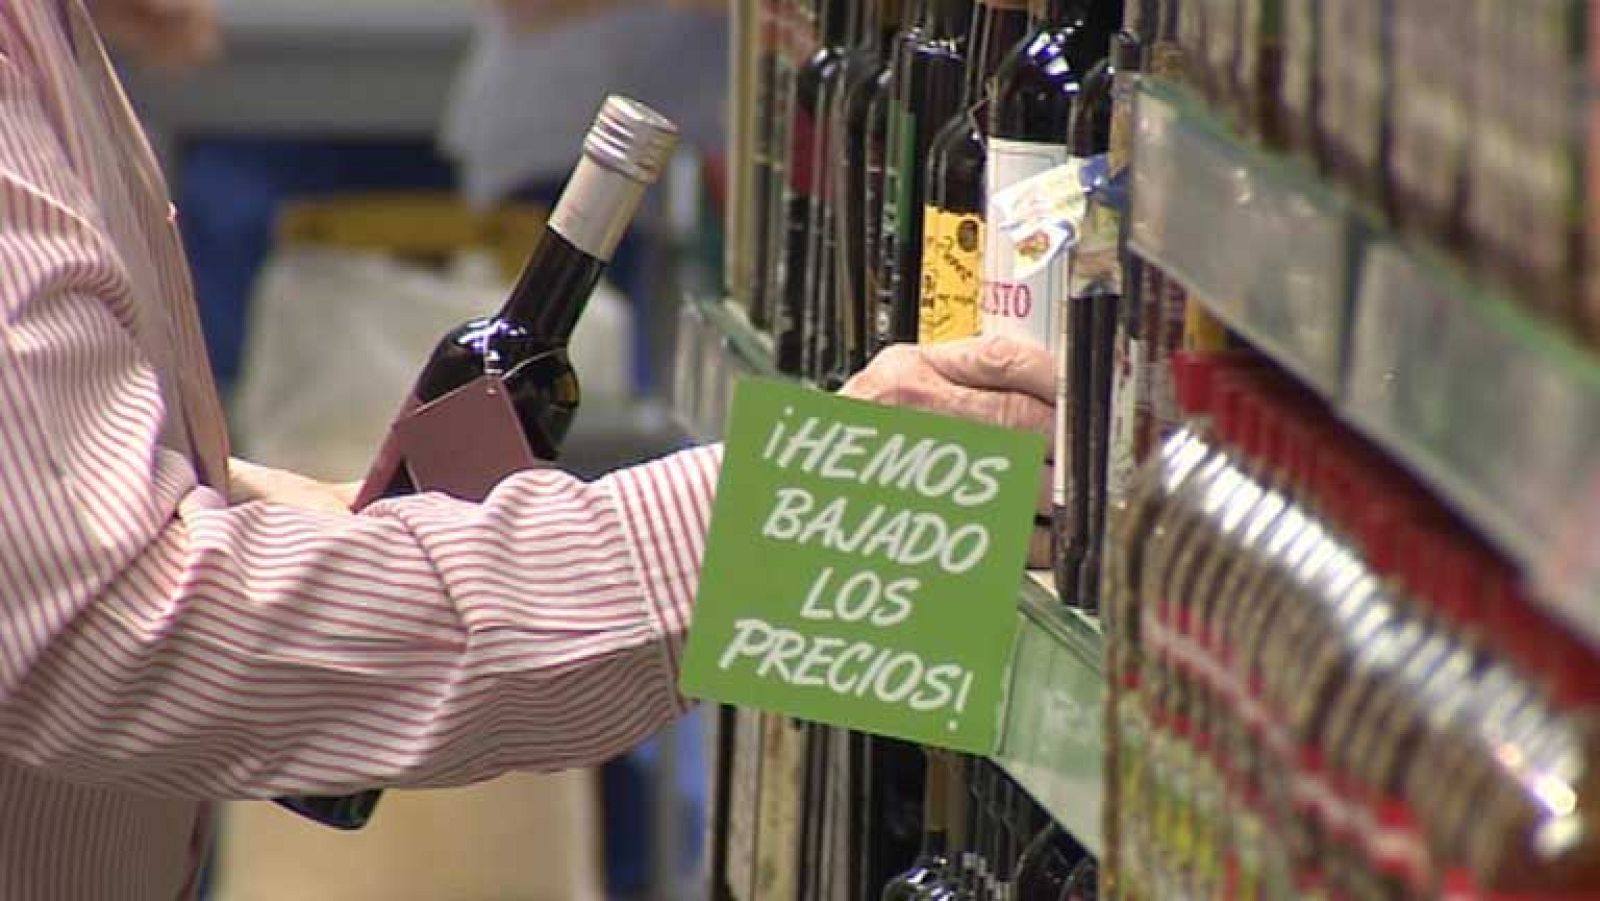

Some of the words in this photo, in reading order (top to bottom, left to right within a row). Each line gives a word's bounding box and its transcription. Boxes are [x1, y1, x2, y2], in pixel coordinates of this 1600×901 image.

[764, 406, 1010, 506] ¡HEMOS
[763, 488, 989, 574] BAJADO
[800, 567, 921, 626] LOS
[718, 618, 974, 731] PRECIOS!
